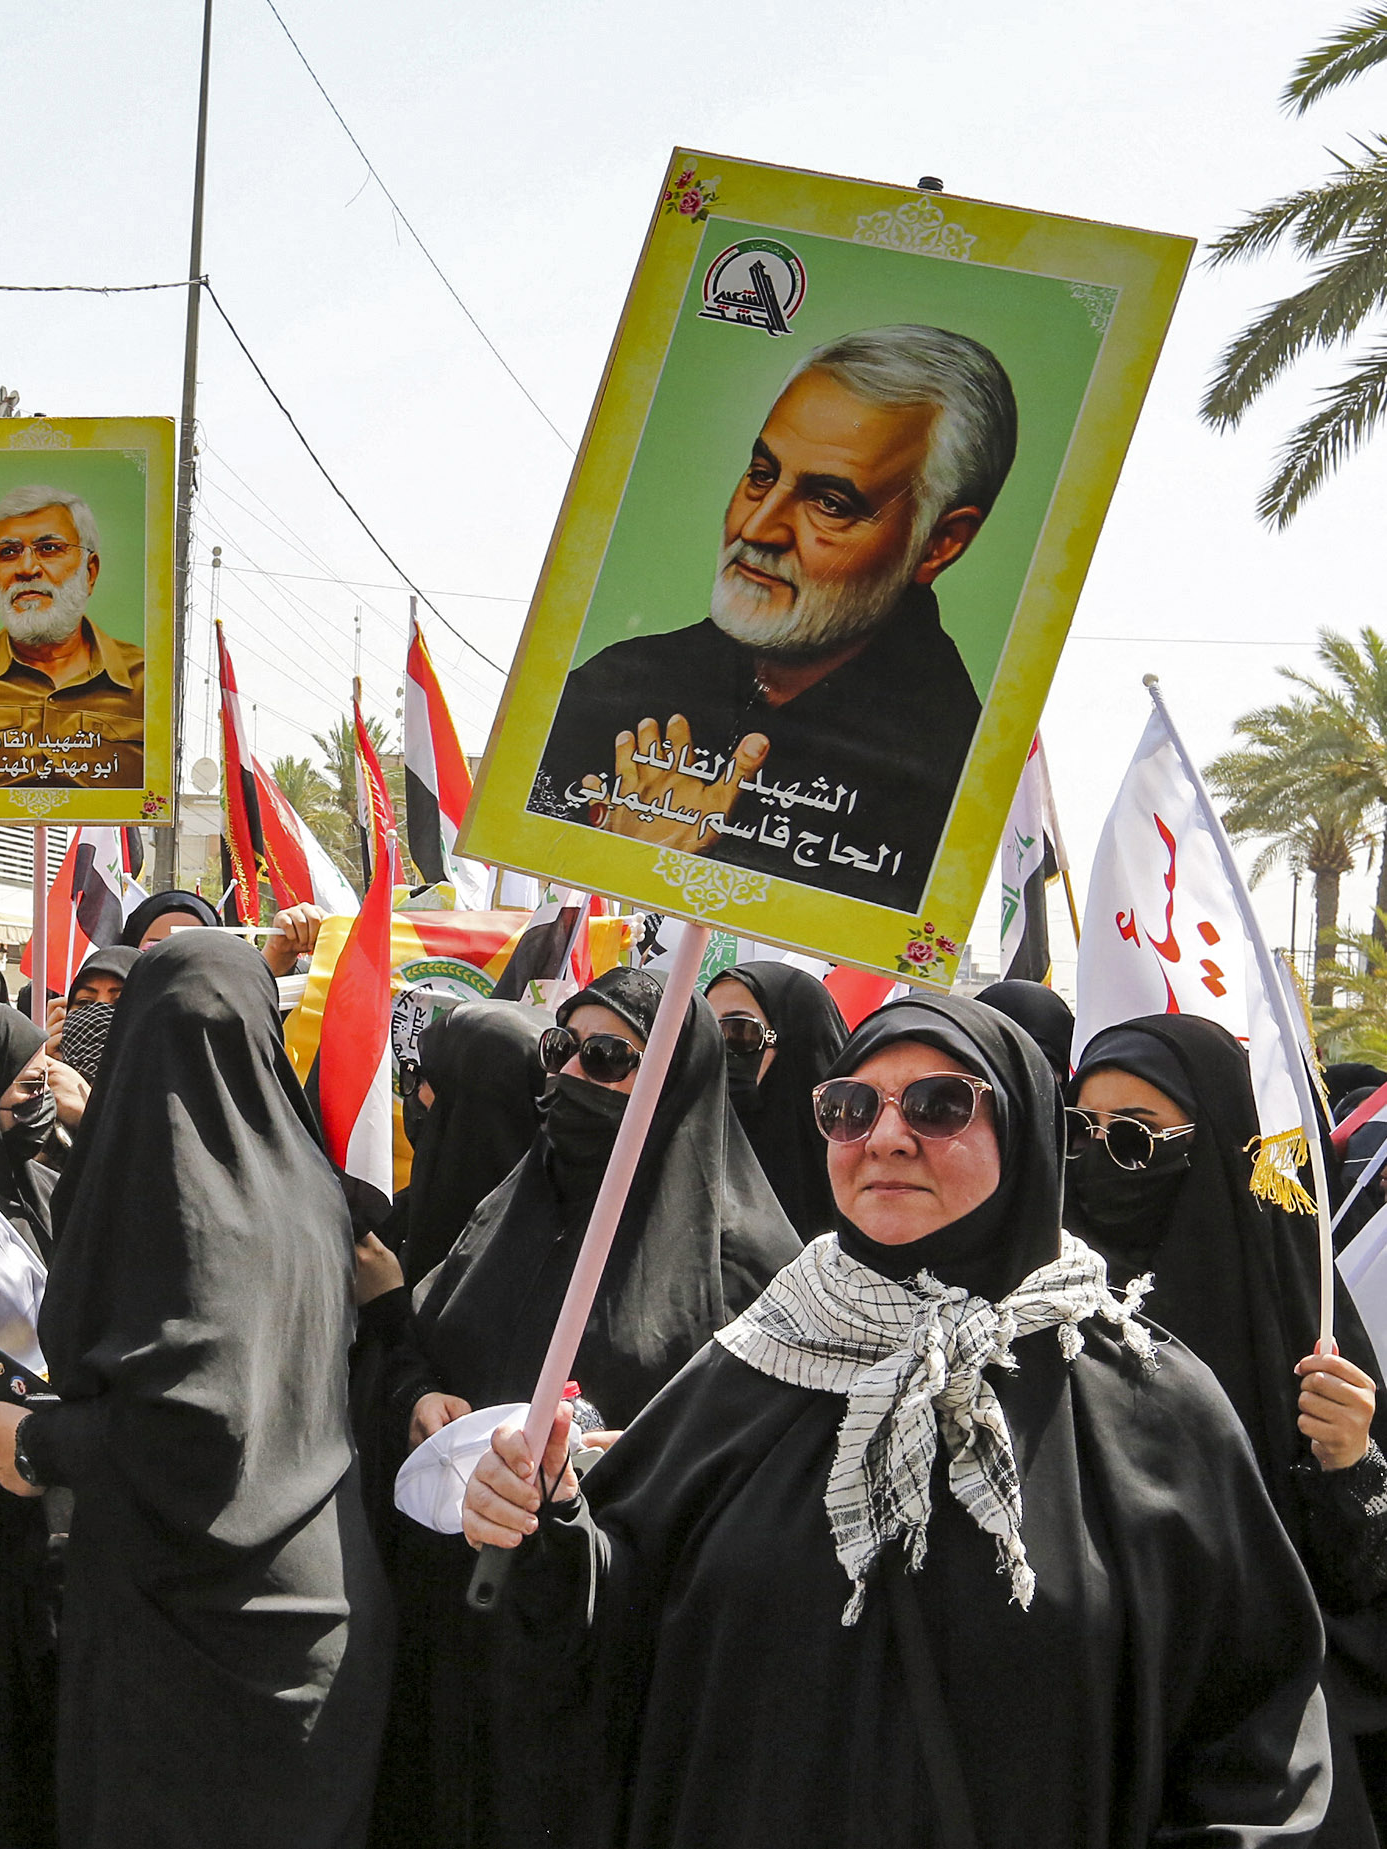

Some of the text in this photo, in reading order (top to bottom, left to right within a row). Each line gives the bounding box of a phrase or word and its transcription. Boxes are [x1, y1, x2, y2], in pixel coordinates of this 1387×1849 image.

[38, 730, 101, 753] الشهيد
[37, 758, 89, 779] مهدي
[90, 753, 119, 779] أبو
[631, 739, 858, 816] الشهيد القائد
[564, 771, 904, 876] الحاج قاسم سليماني
